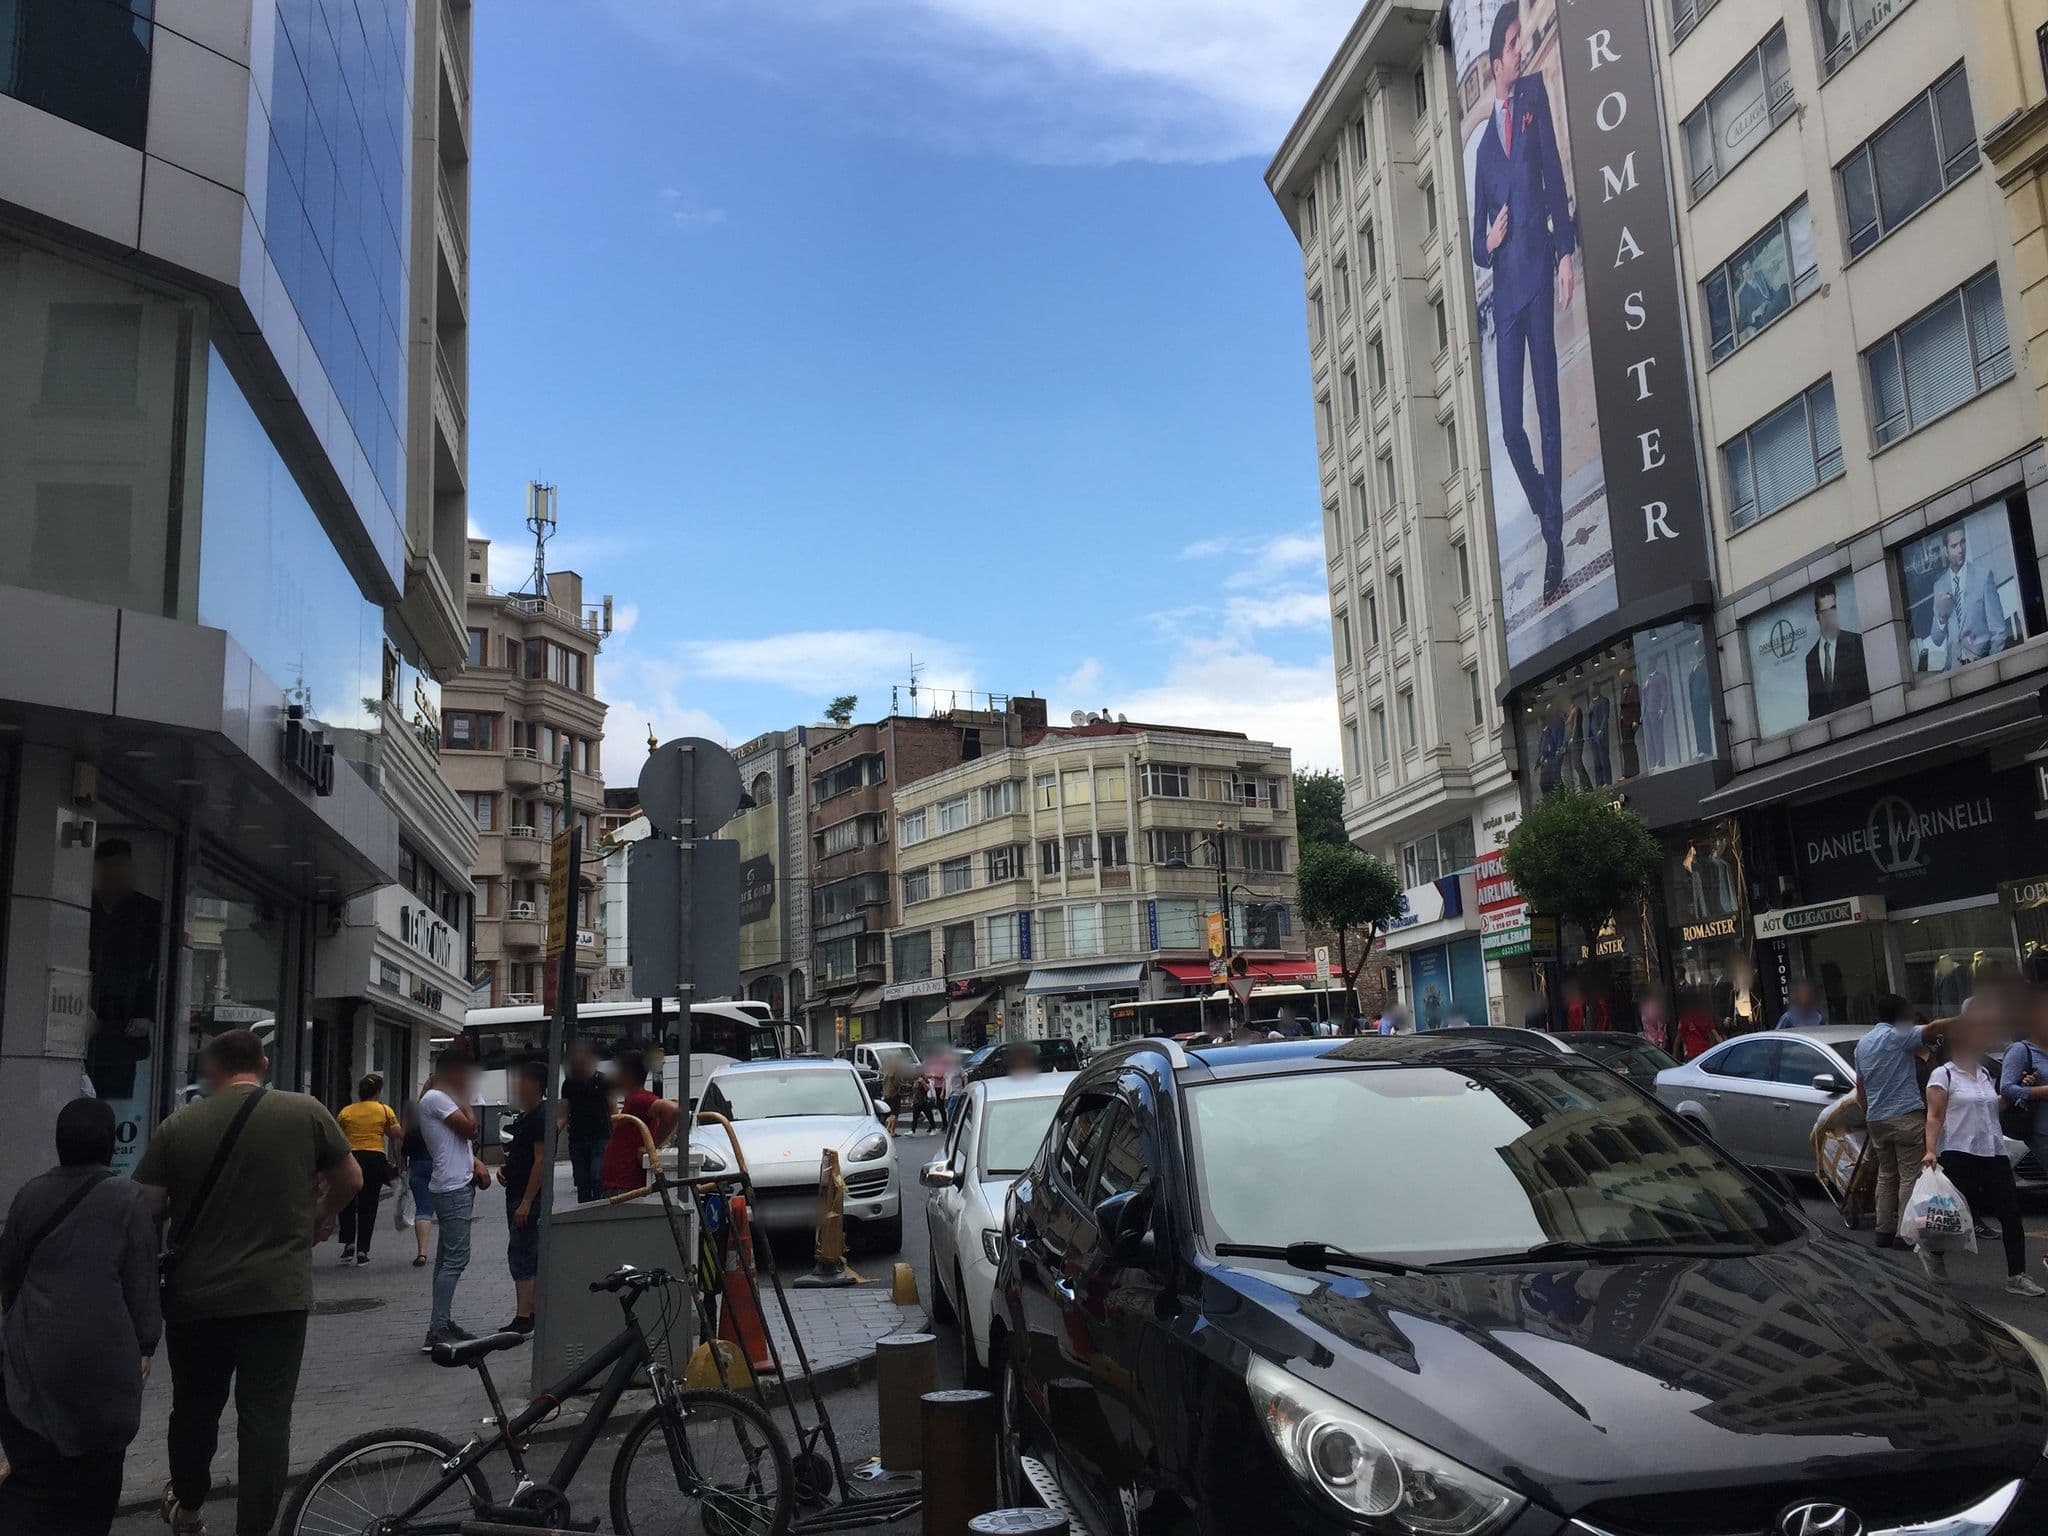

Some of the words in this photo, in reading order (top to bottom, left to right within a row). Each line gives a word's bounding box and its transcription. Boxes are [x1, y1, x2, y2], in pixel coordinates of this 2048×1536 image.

[1585, 28, 1680, 544] ROMASTER
[1807, 826, 1882, 864] DANIELE
[1888, 798, 1994, 847] MARINELLI
[1478, 880, 1520, 906] AIRLINE
[1682, 919, 1736, 941] ROMASTER
[1762, 917, 1782, 932] AGT
[1786, 906, 1851, 929] ALLIGATTOR
[1581, 938, 1624, 958] RASTER
[1776, 954, 1790, 1005] TOSUN
[50, 988, 83, 1016] into
